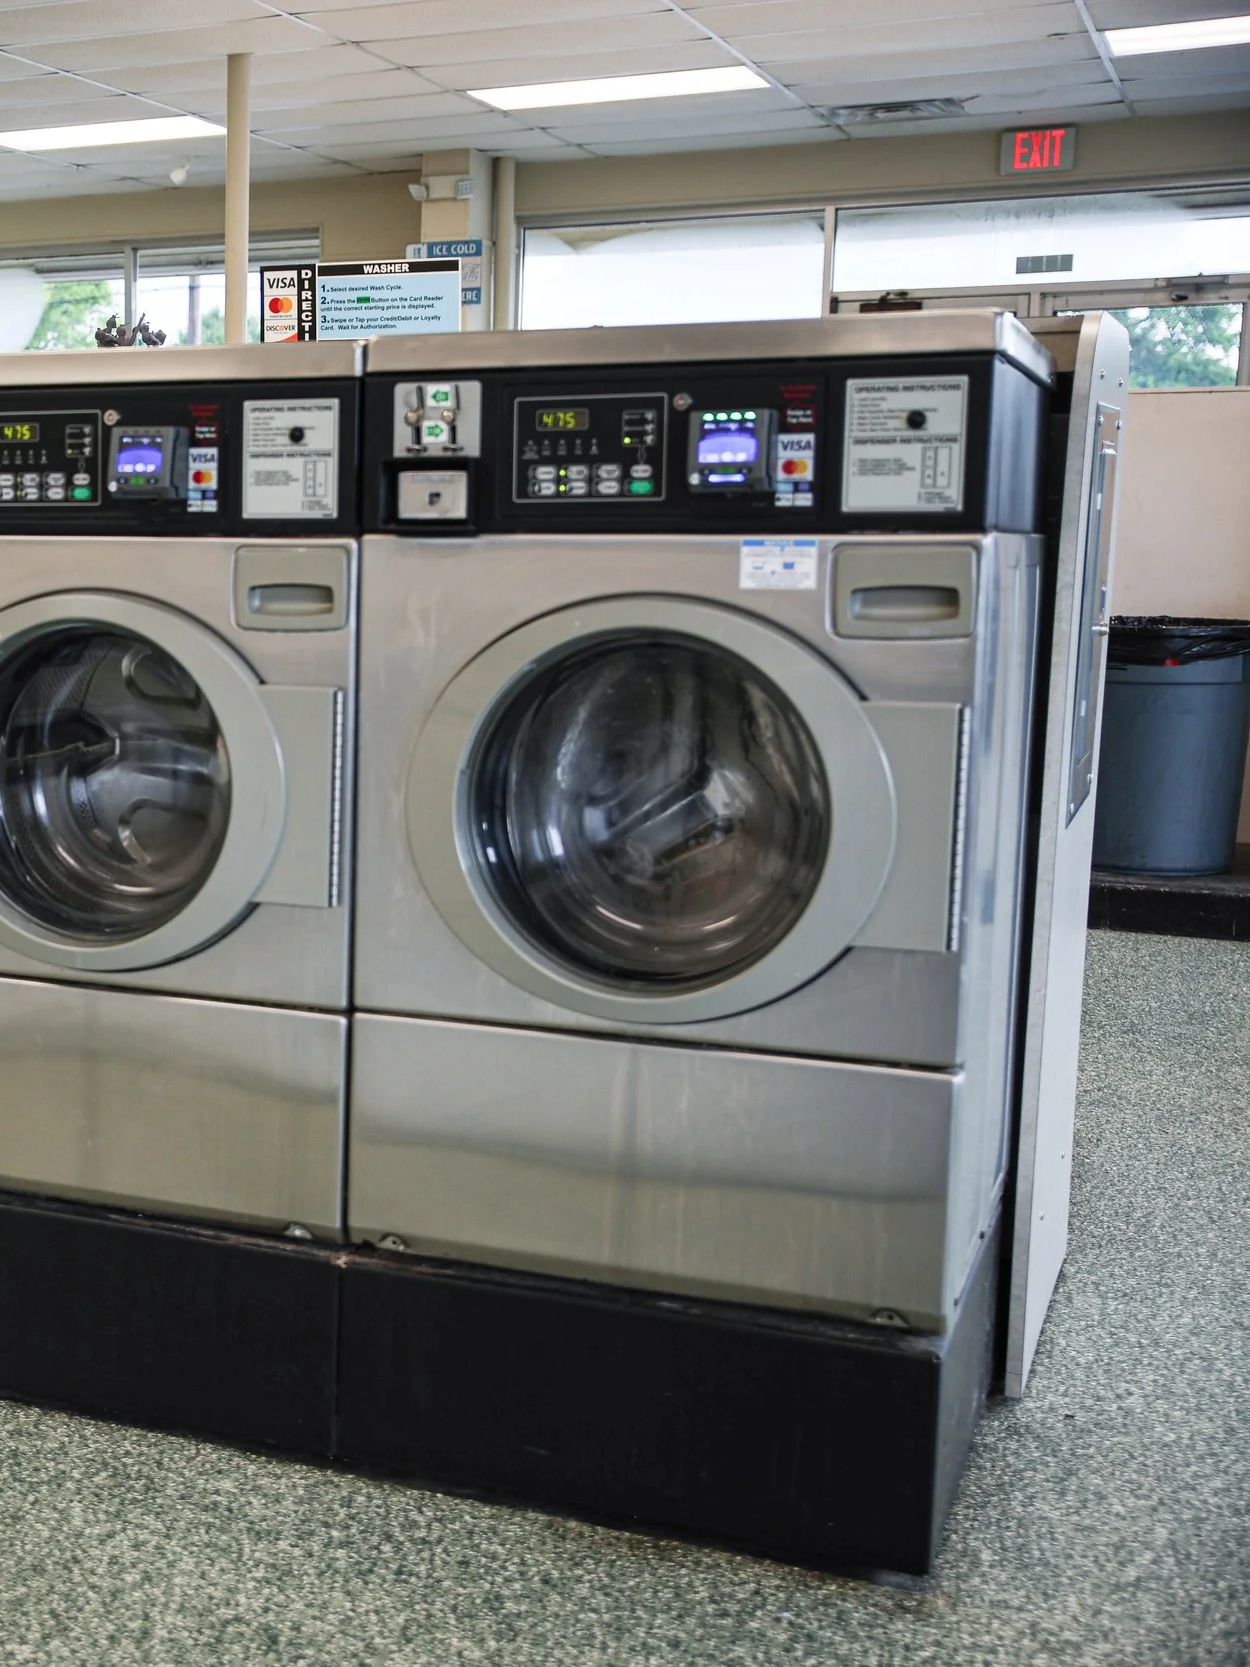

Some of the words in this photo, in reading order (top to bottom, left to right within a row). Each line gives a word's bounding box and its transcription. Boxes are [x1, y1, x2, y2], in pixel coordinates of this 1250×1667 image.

[1013, 129, 1066, 170] EXIT
[433, 244, 448, 256] ICE
[451, 243, 477, 255] COLD
[363, 263, 410, 274] WASHER
[266, 277, 297, 289] VISA
[320, 285, 330, 293] 1.
[320, 297, 330, 305] 2.
[320, 315, 330, 323] 3.
[420, 314, 441, 322] Loyalty
[854, 385, 900, 394] OPERATING
[902, 383, 962, 392] INSTRUCTIONS
[542, 411, 576, 428] 475
[3, 424, 31, 440] 475
[780, 440, 813, 452] VISA
[190, 453, 216, 464] VISA
